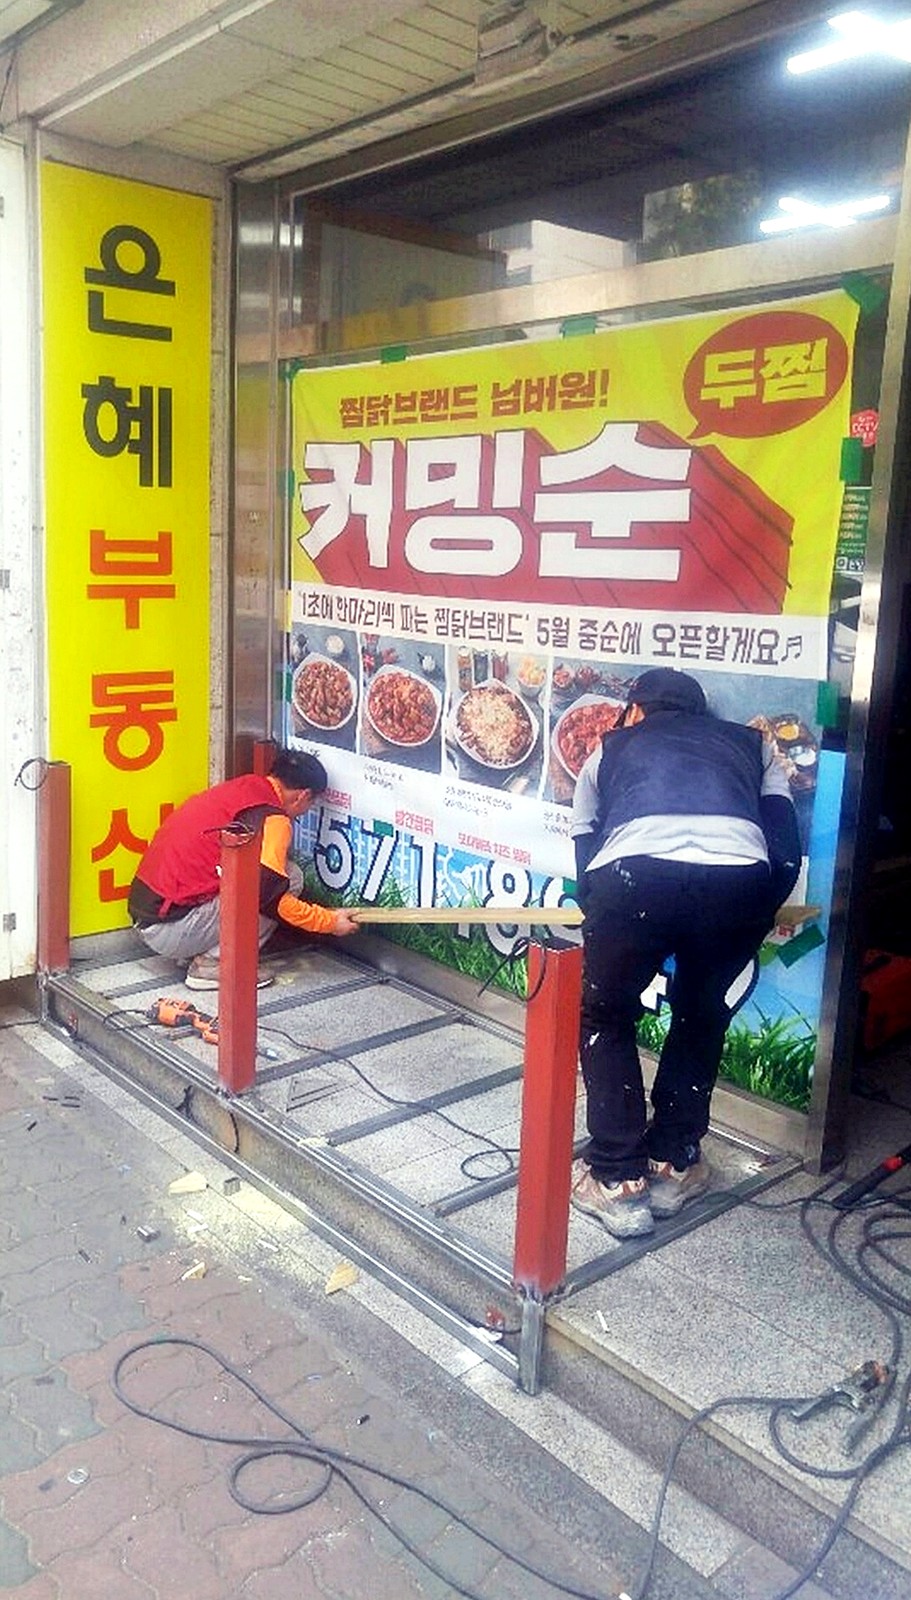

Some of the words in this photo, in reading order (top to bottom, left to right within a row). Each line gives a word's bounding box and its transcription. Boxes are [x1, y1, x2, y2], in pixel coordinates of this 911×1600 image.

[339, 384, 478, 429] 찜닭브랜드
[491, 369, 610, 417] 넘버원!
[700, 337, 828, 409] 두찜
[298, 421, 692, 582] 커밍순
[400, 604, 429, 634] 파는
[536, 616, 570, 648] 5월
[578, 618, 642, 656] 중순에
